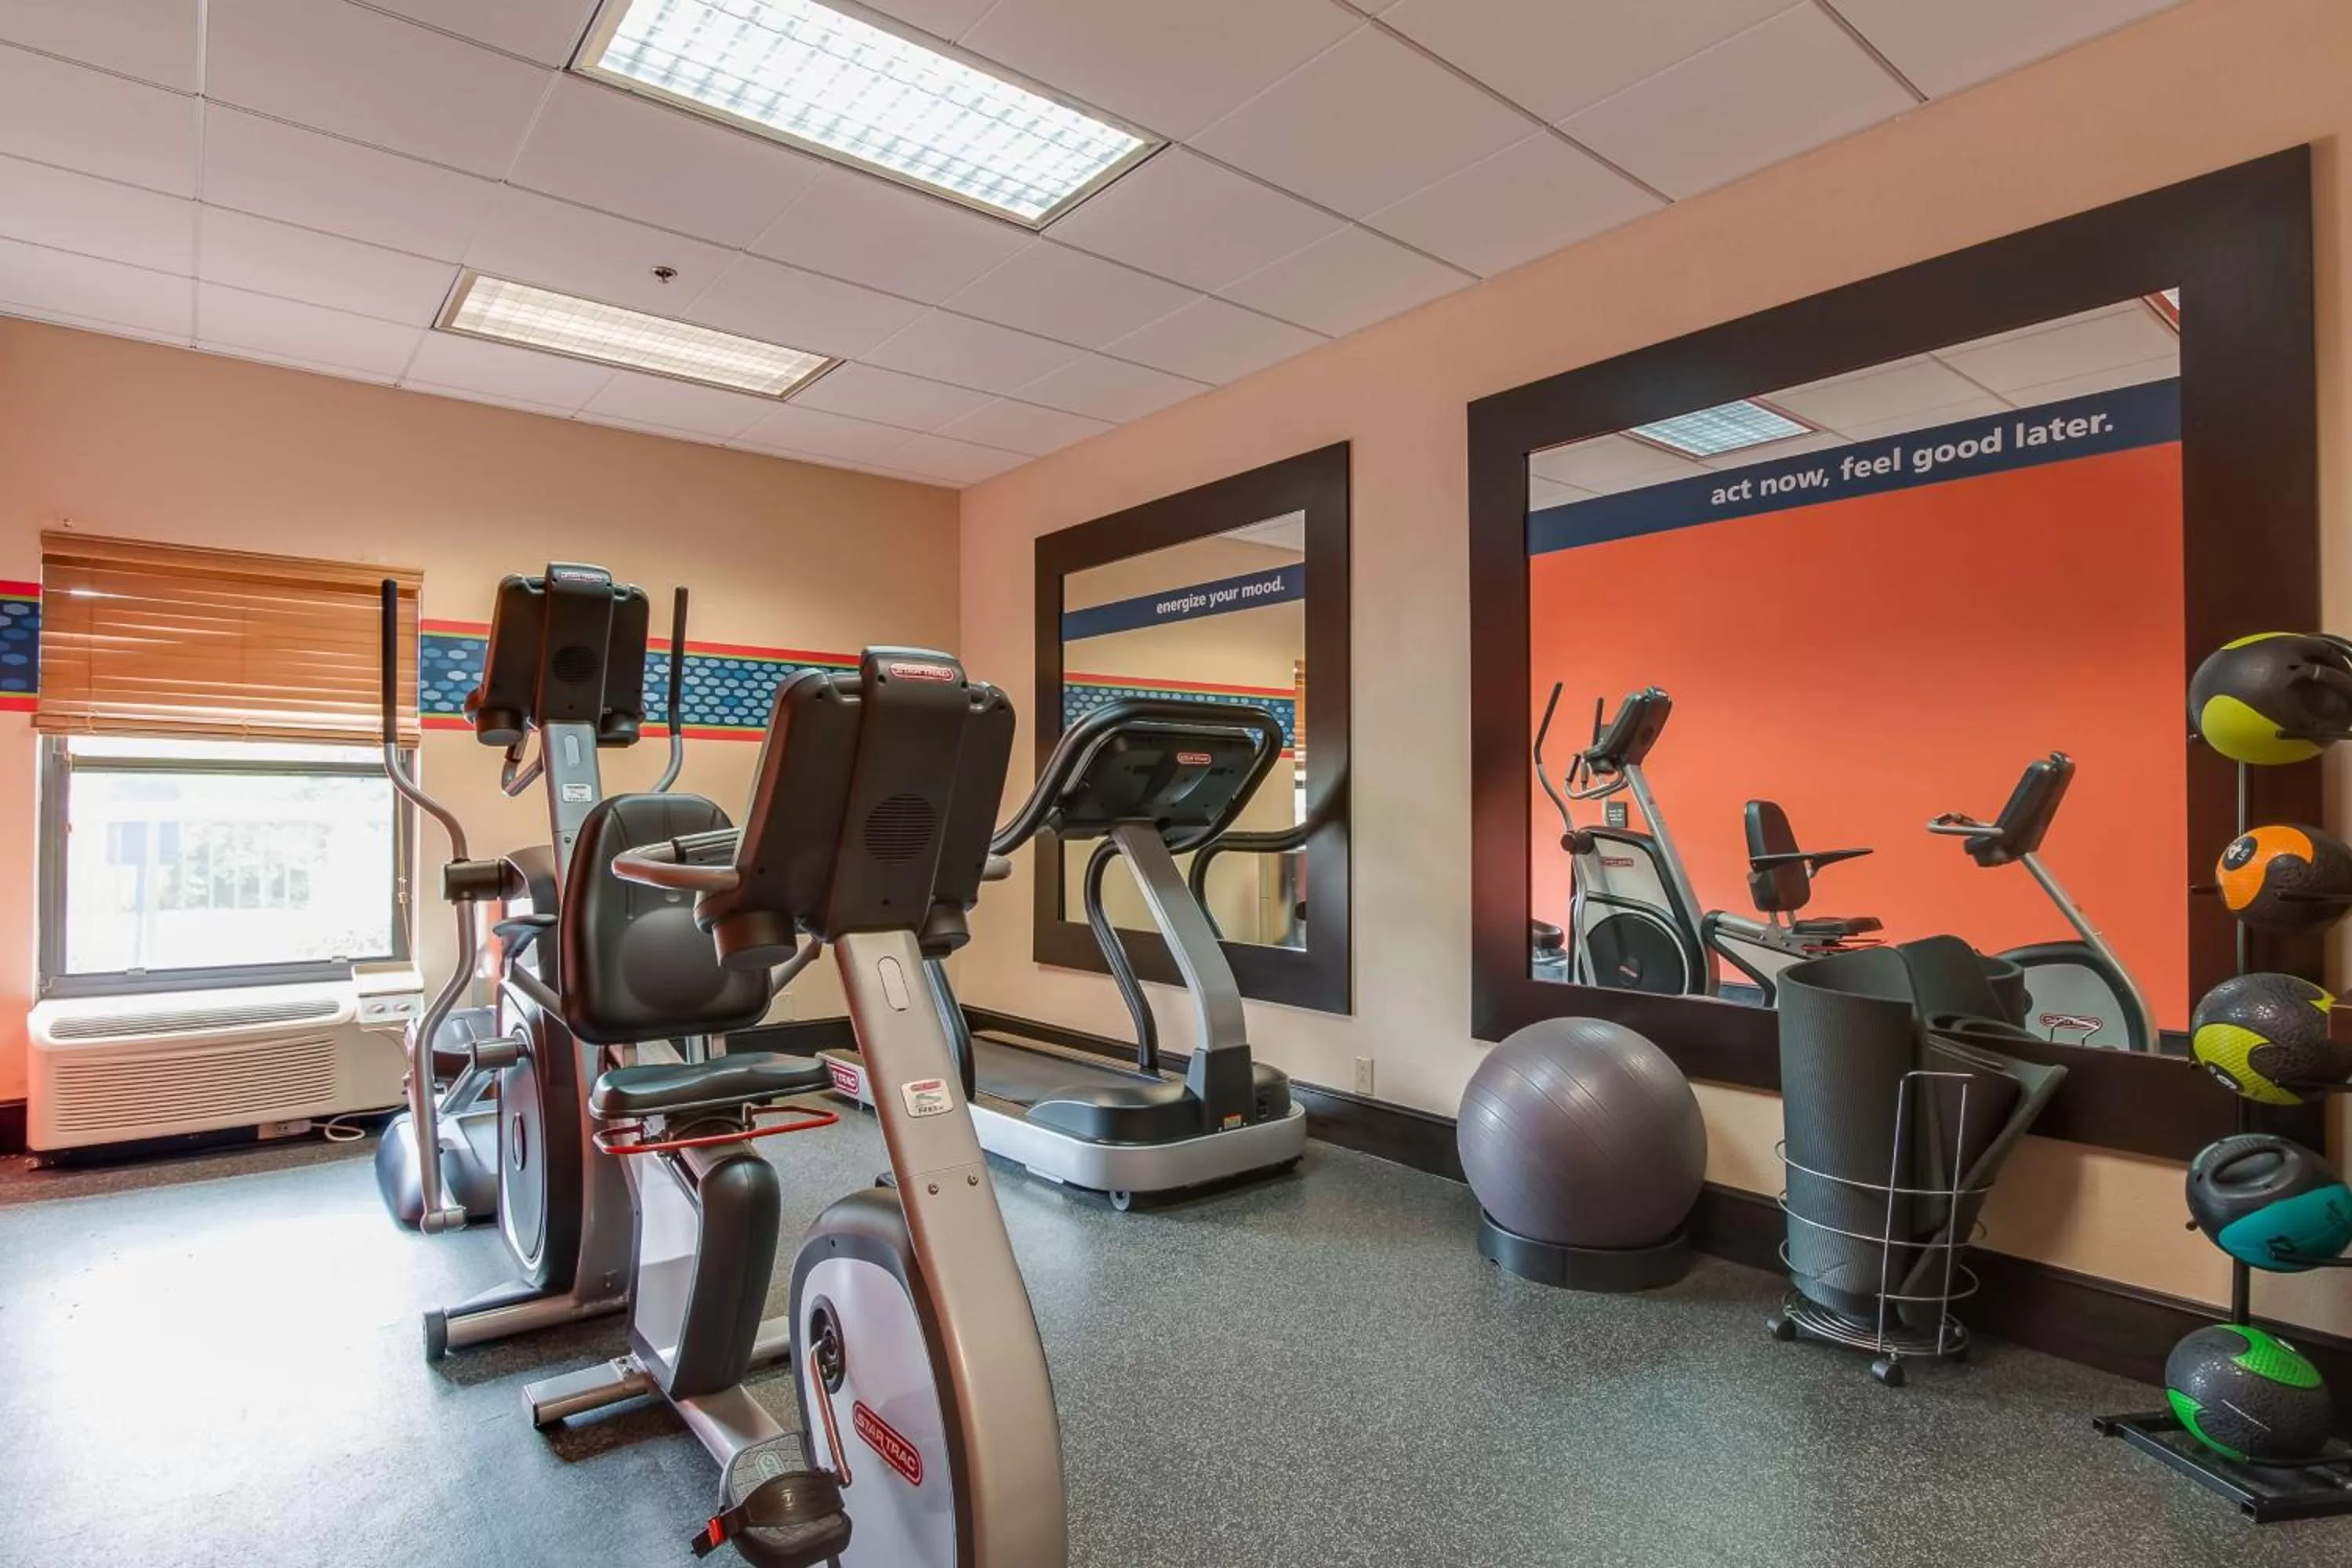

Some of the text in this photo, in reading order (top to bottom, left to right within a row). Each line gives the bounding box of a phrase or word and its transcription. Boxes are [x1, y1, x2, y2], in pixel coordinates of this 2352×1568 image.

[1711, 413, 2114, 505] act now, feel good later.
[1156, 575, 1285, 614] energize your mood.
[856, 1413, 916, 1472] STAR TRAC
